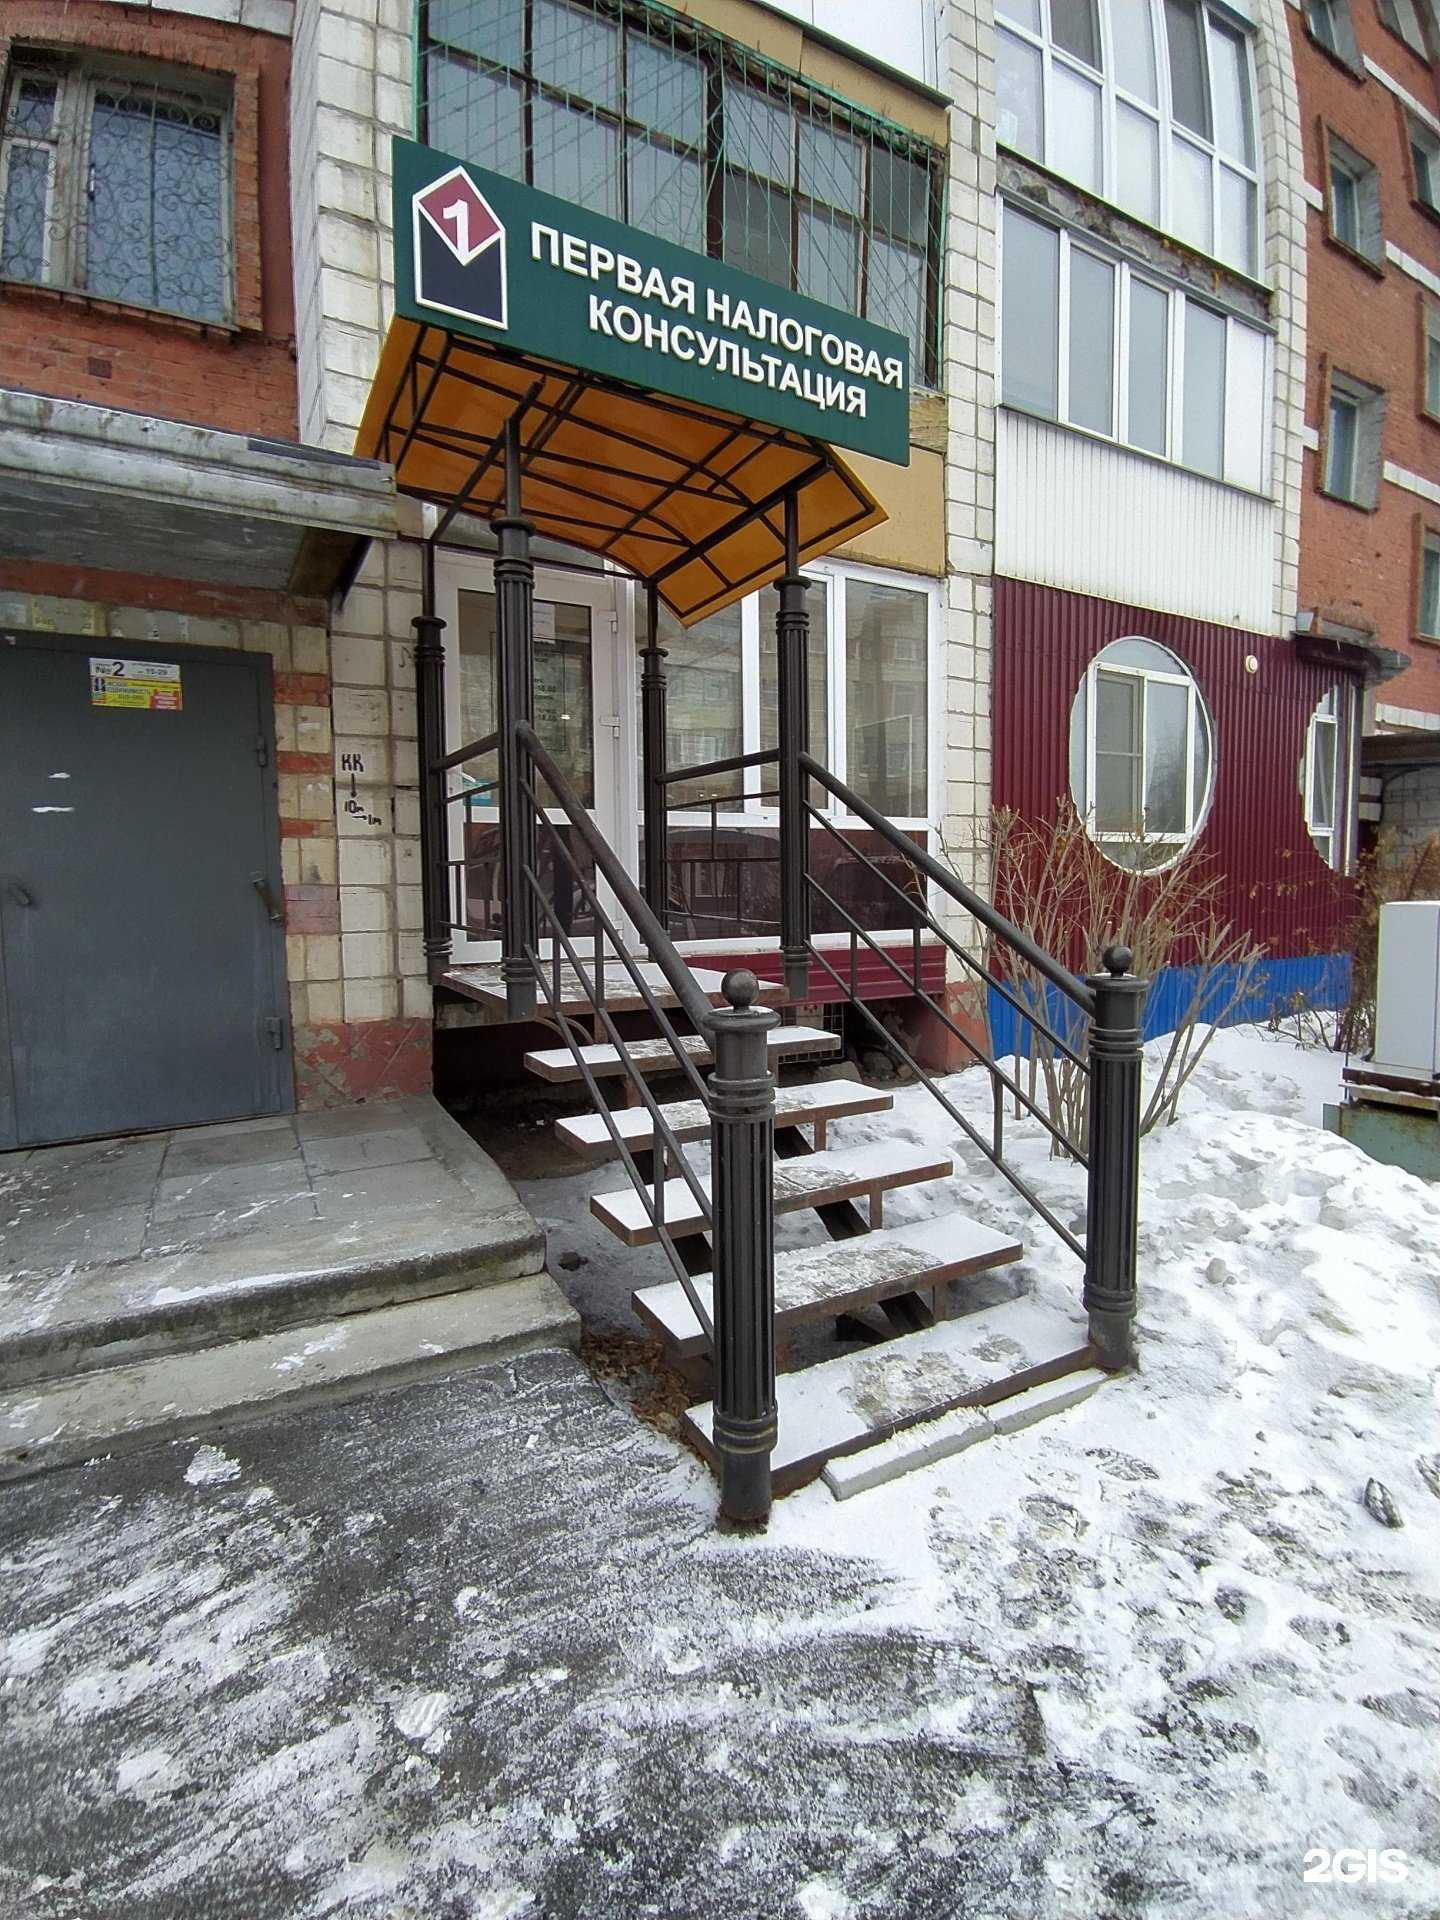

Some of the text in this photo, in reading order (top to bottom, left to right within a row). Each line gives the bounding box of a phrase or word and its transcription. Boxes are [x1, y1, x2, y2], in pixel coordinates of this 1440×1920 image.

[443, 198, 470, 257] 1
[531, 222, 904, 390] ПЕРВАЯ НАЛОГОВАЯ
[589, 295, 867, 418] КОНСУЛЬТАЦИЯ
[112, 661, 125, 677] 2
